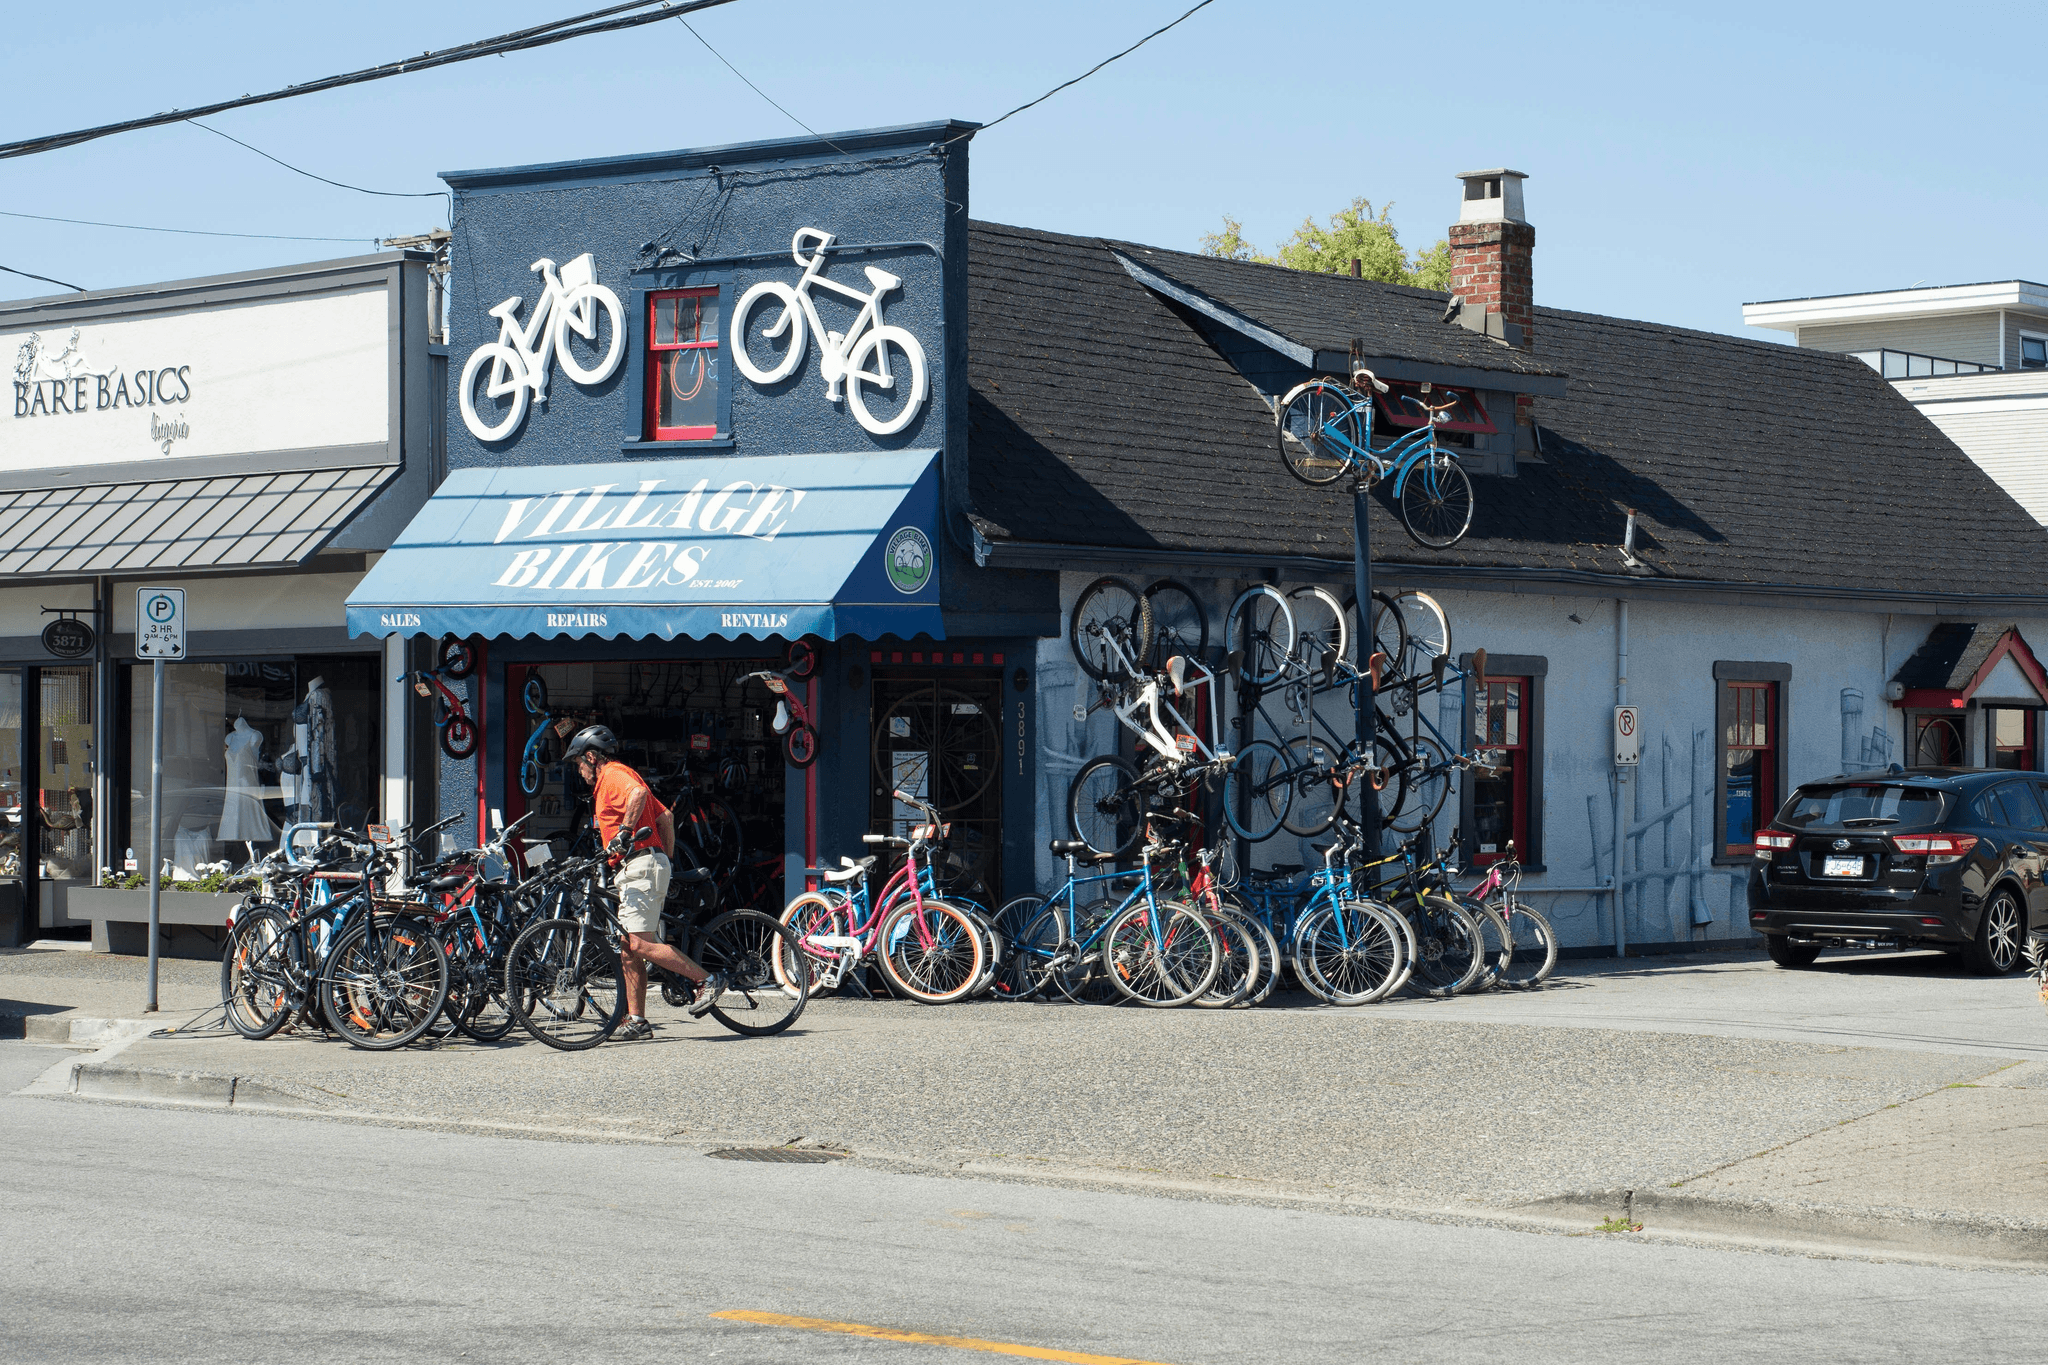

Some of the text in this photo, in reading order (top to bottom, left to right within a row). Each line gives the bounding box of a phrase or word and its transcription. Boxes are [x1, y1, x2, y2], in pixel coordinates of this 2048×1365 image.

[14, 365, 191, 418] BARE BASICS
[494, 478, 808, 543] VILLAGE
[889, 531, 912, 555] VILLAGE
[490, 541, 712, 590] BIKES
[688, 579, 744, 589] EST. 2007
[155, 601, 168, 617] P
[150, 625, 173, 633] 3 HR
[380, 613, 788, 628] SALES REPAIRS RENTALS
[52, 635, 85, 648] 3871
[1017, 701, 1026, 776] 3891
